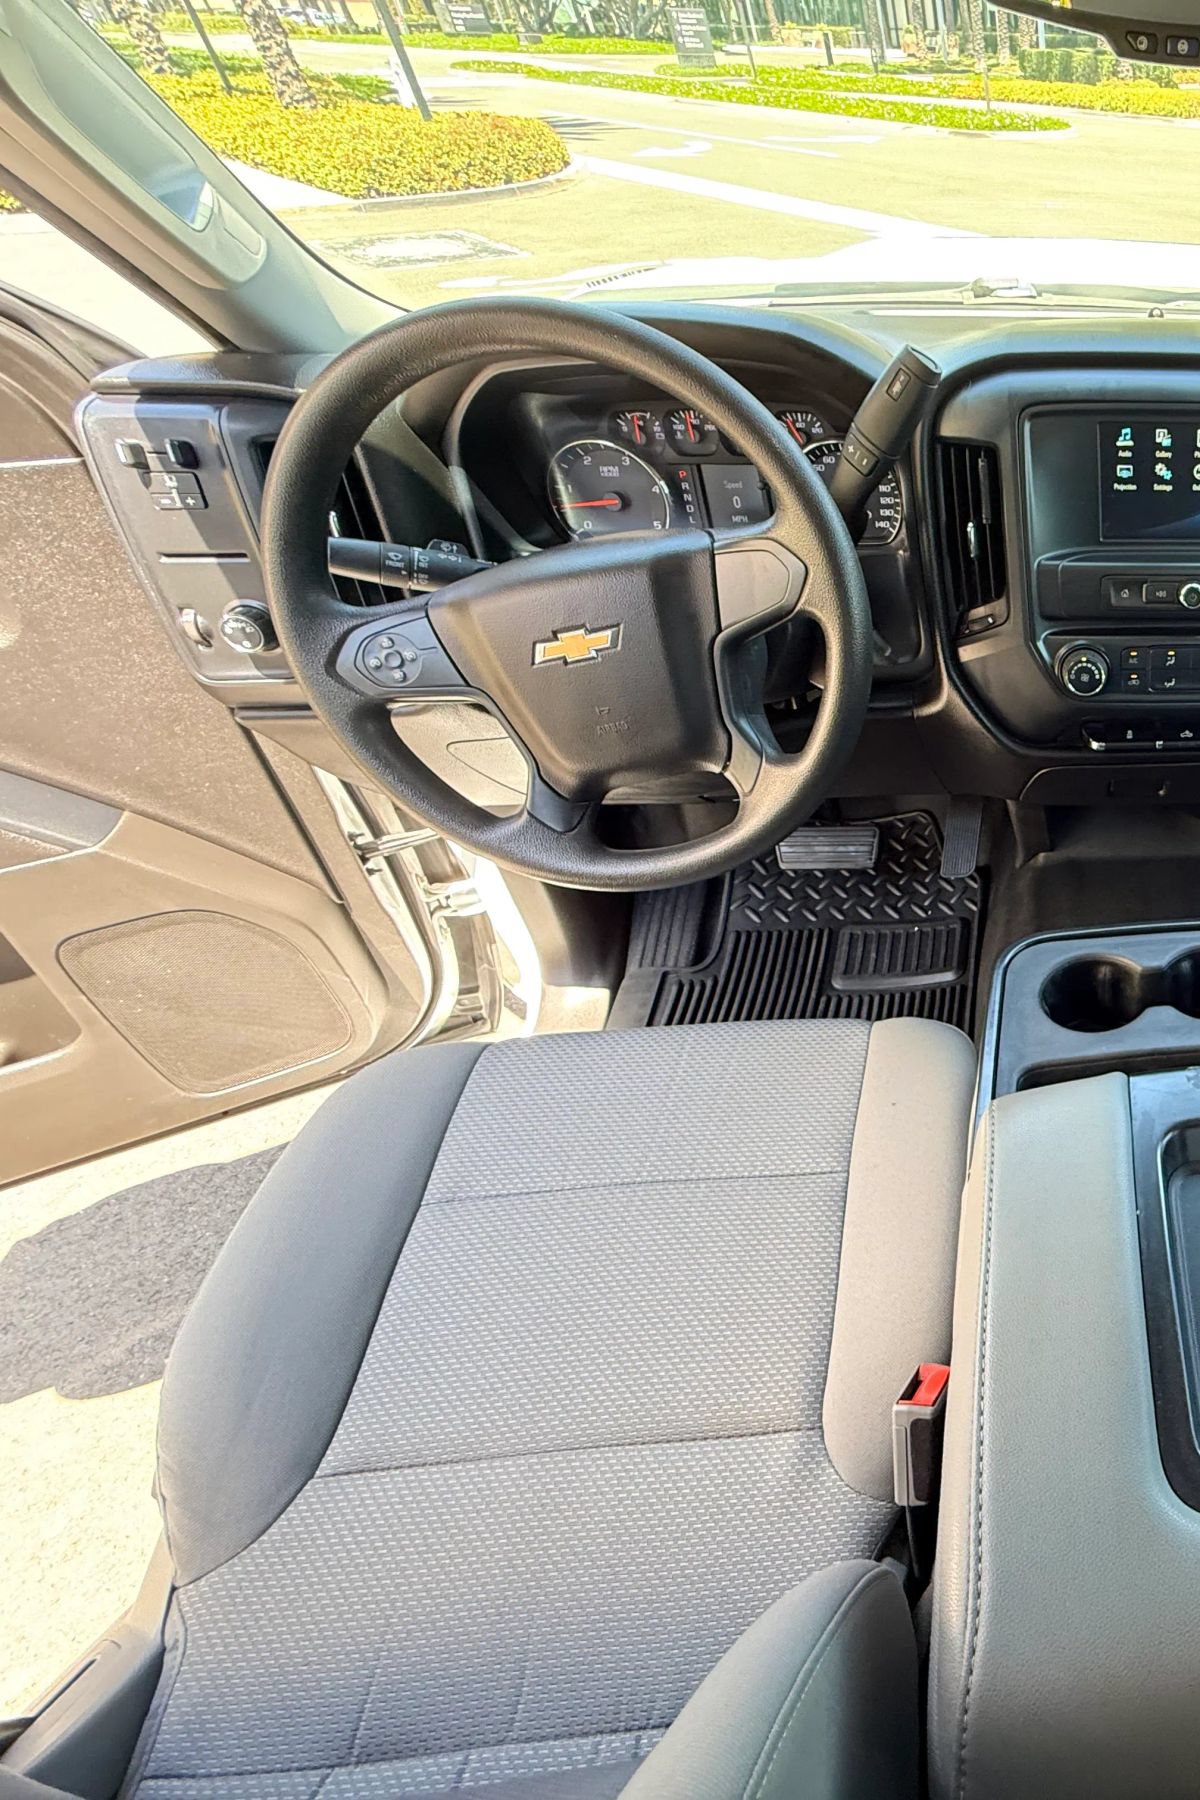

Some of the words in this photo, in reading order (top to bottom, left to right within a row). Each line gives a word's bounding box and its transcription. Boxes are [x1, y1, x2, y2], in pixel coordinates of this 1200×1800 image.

[1155, 451, 1172, 459] Gallery
[622, 457, 630, 465] 3
[678, 470, 687, 478] P
[652, 485, 659, 493] 4
[681, 482, 690, 490] R
[723, 480, 743, 490] Speed
[1113, 483, 1137, 491] Projection
[1153, 483, 1173, 491] Settings
[683, 494, 692, 502] N
[732, 495, 741, 509] 0
[880, 496, 894, 504] 120
[731, 515, 749, 523] MPH
[584, 521, 592, 529] 0
[653, 521, 662, 529] 5
[875, 520, 890, 528] 140
[385, 559, 405, 568] FRONT
